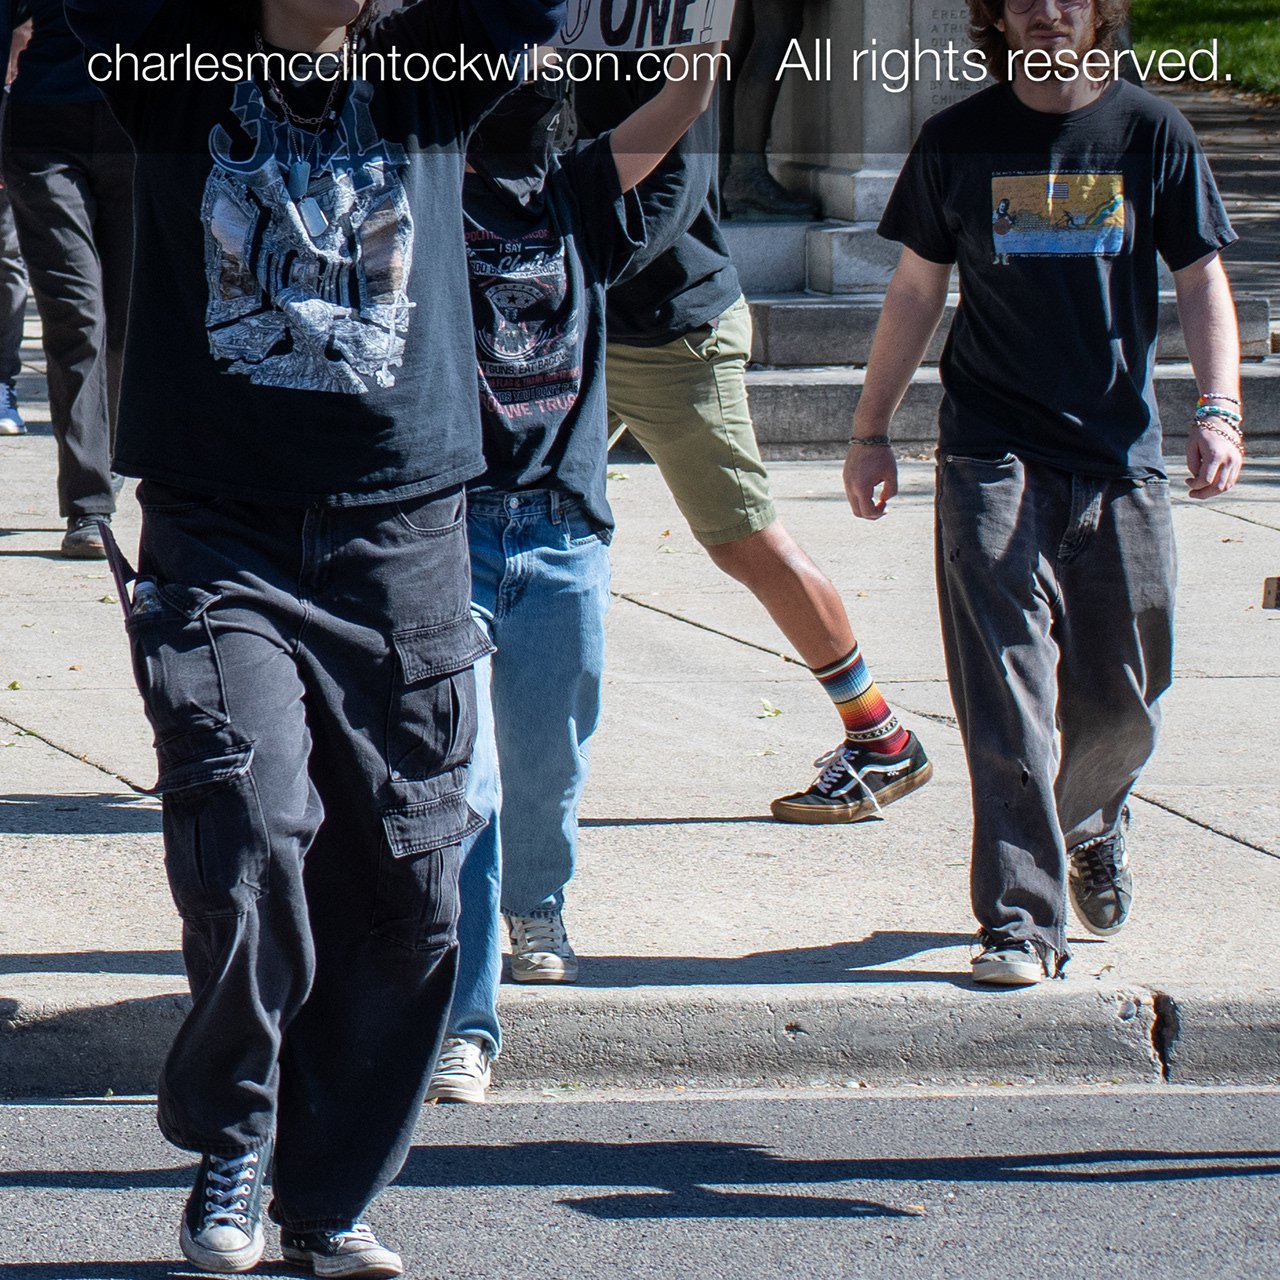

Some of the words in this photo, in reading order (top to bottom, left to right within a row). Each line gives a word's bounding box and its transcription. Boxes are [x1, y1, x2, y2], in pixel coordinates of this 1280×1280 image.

[931, 9, 968, 20] EREC
[504, 242, 522, 253] SAY
[518, 361, 536, 374] EAT
